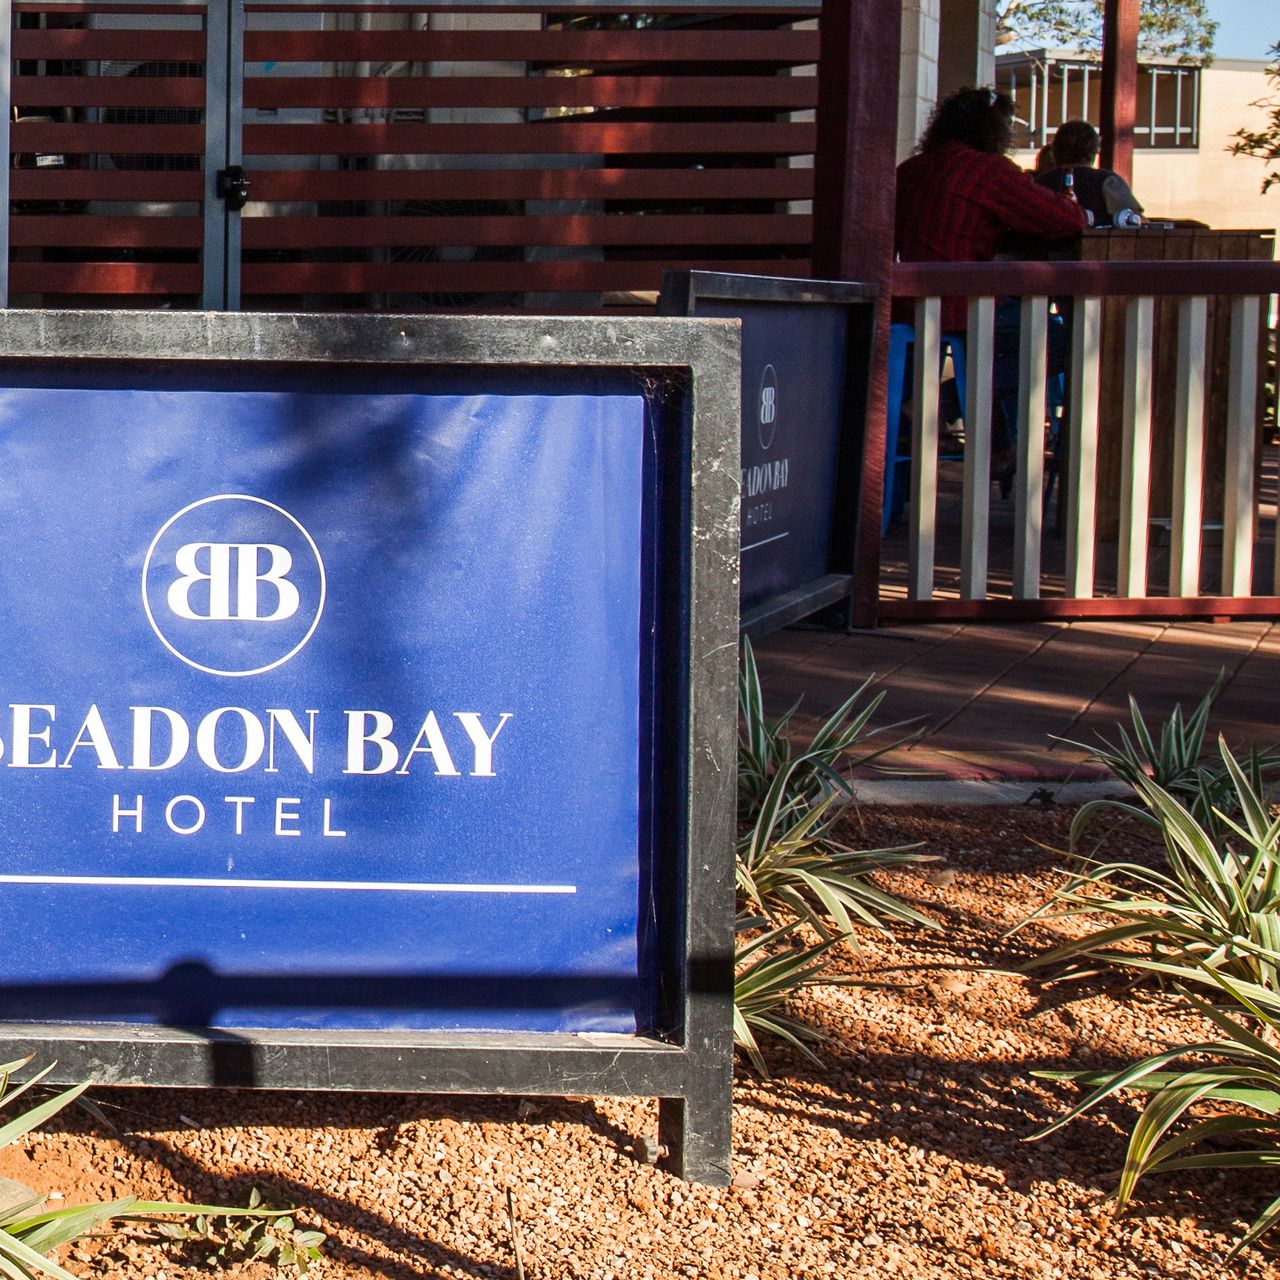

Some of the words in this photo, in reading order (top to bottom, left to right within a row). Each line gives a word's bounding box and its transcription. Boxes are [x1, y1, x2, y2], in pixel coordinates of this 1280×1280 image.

[740, 462, 772, 499] EADON
[342, 709, 514, 777] BAY
[112, 793, 347, 837] HOTEL
